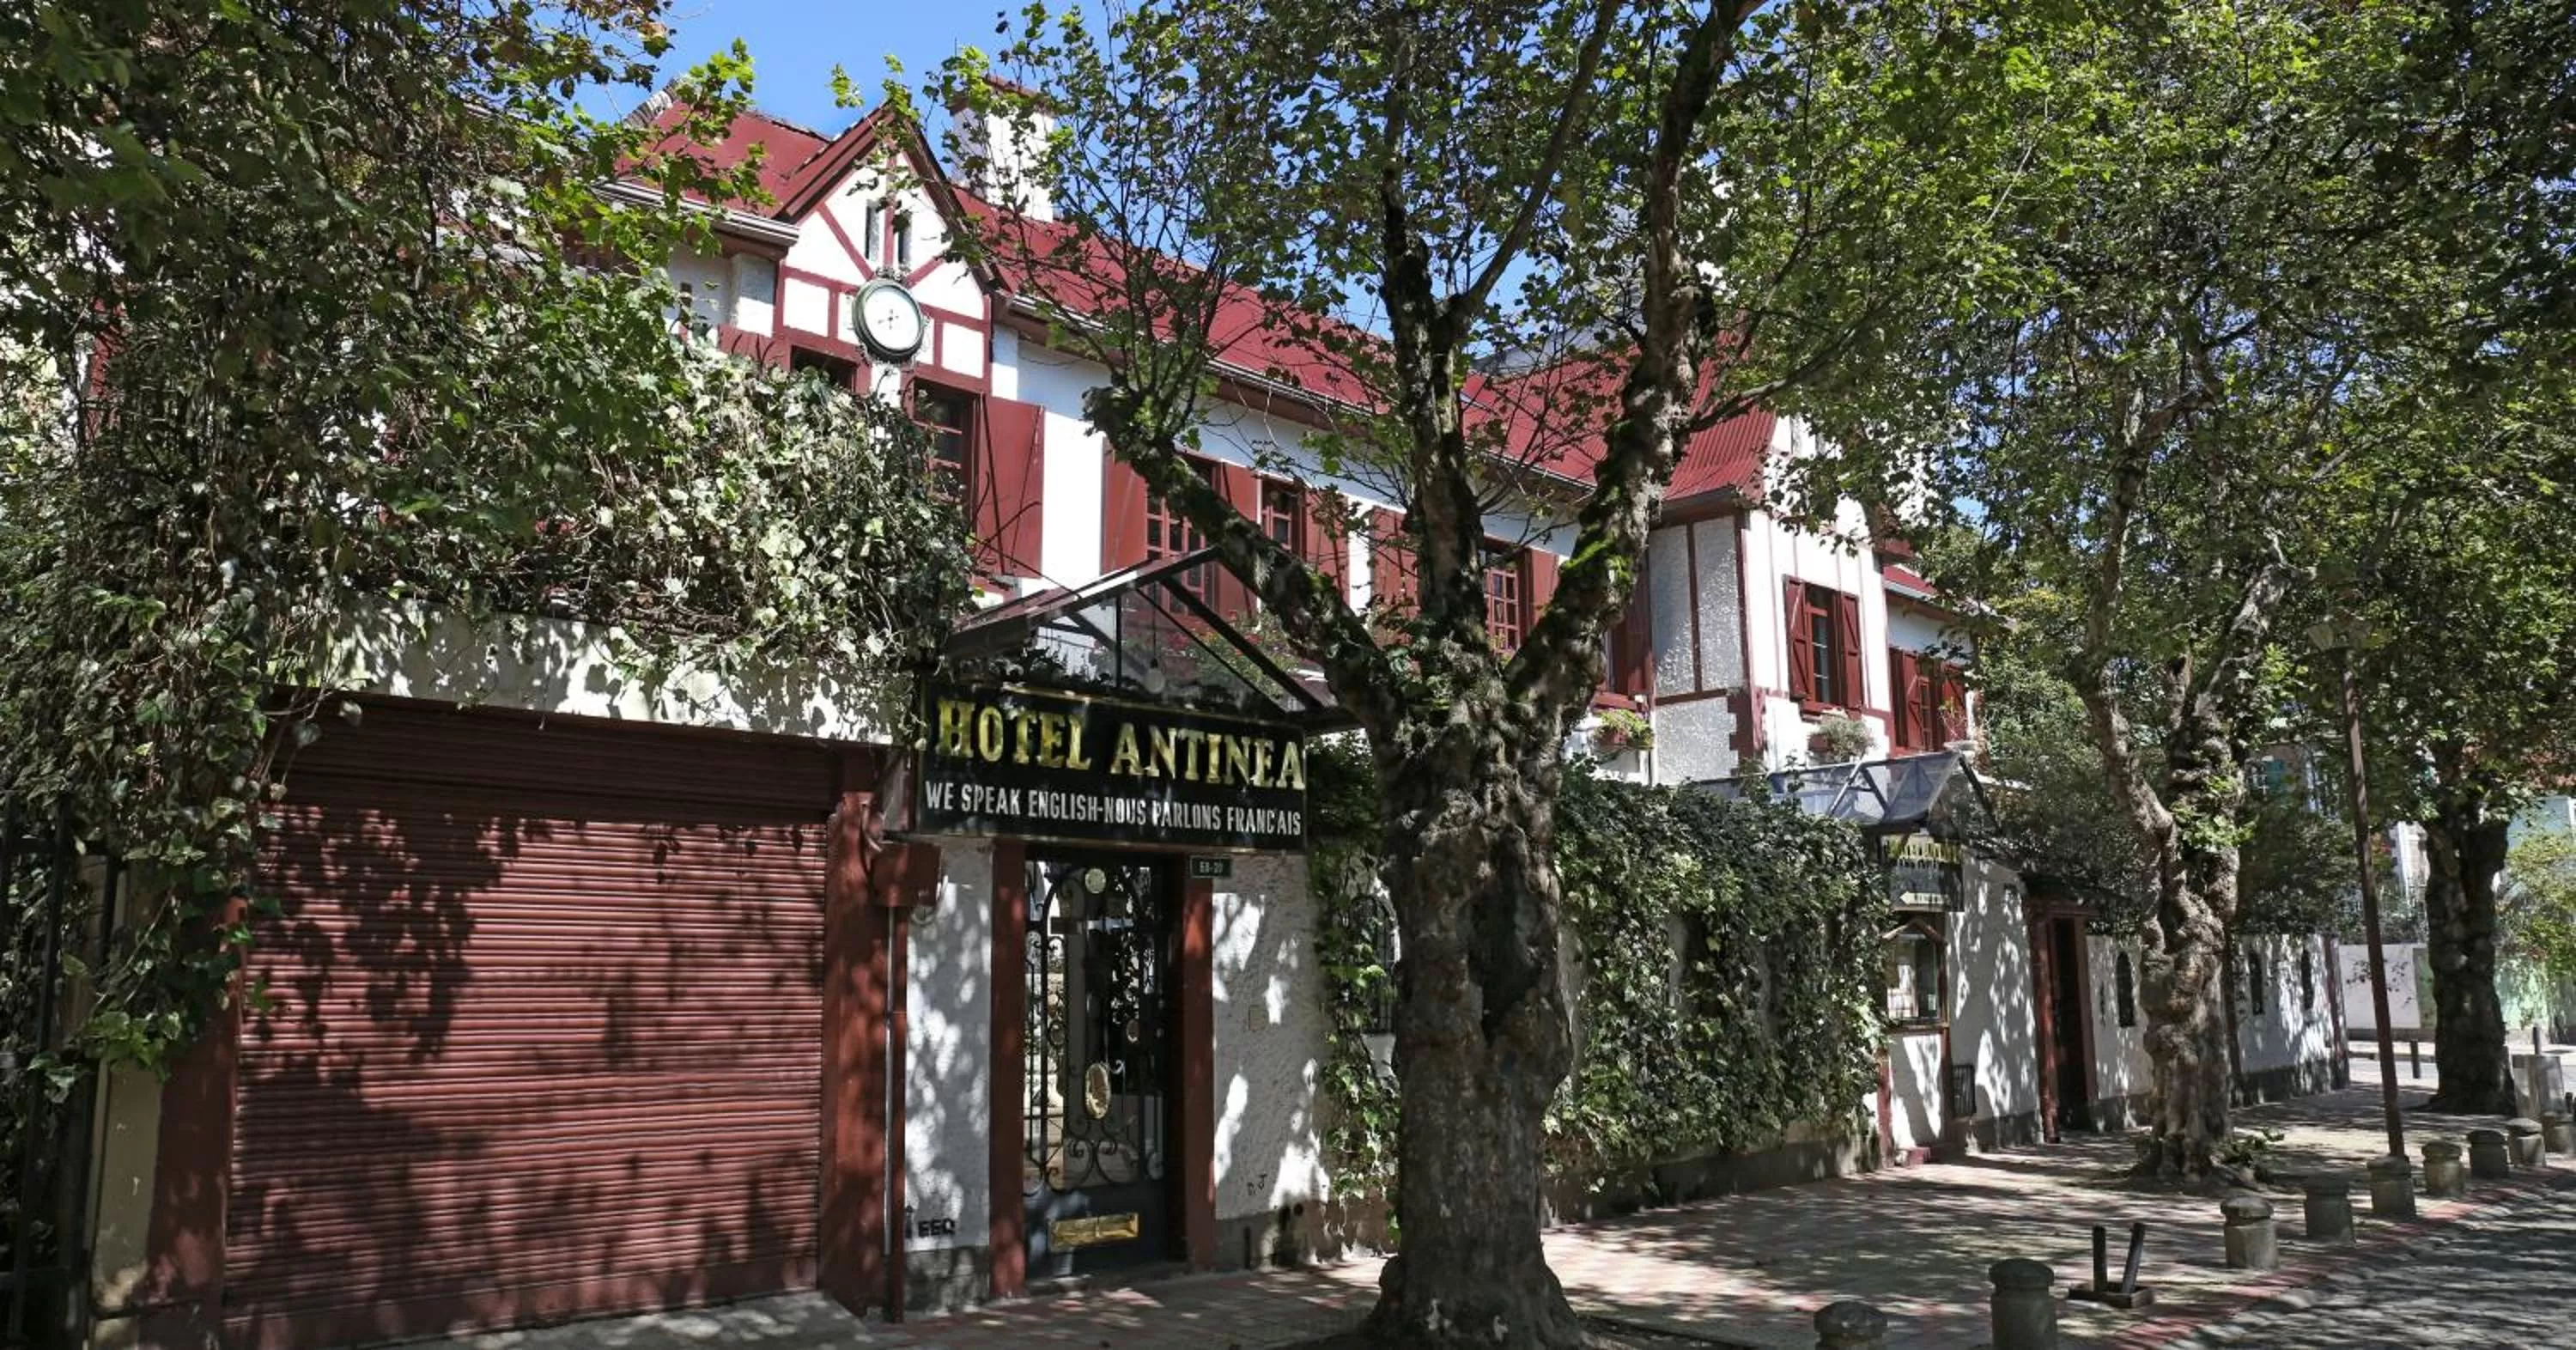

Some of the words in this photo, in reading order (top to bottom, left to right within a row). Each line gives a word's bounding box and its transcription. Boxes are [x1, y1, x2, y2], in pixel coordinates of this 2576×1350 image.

[935, 697, 1092, 770] HOTEL
[1109, 722, 1306, 790] ANTINEA
[925, 780, 955, 811] WE
[961, 783, 1022, 816] SPEAK
[1151, 800, 1223, 830] PARLONS
[1227, 806, 1303, 836] FRANCAIS
